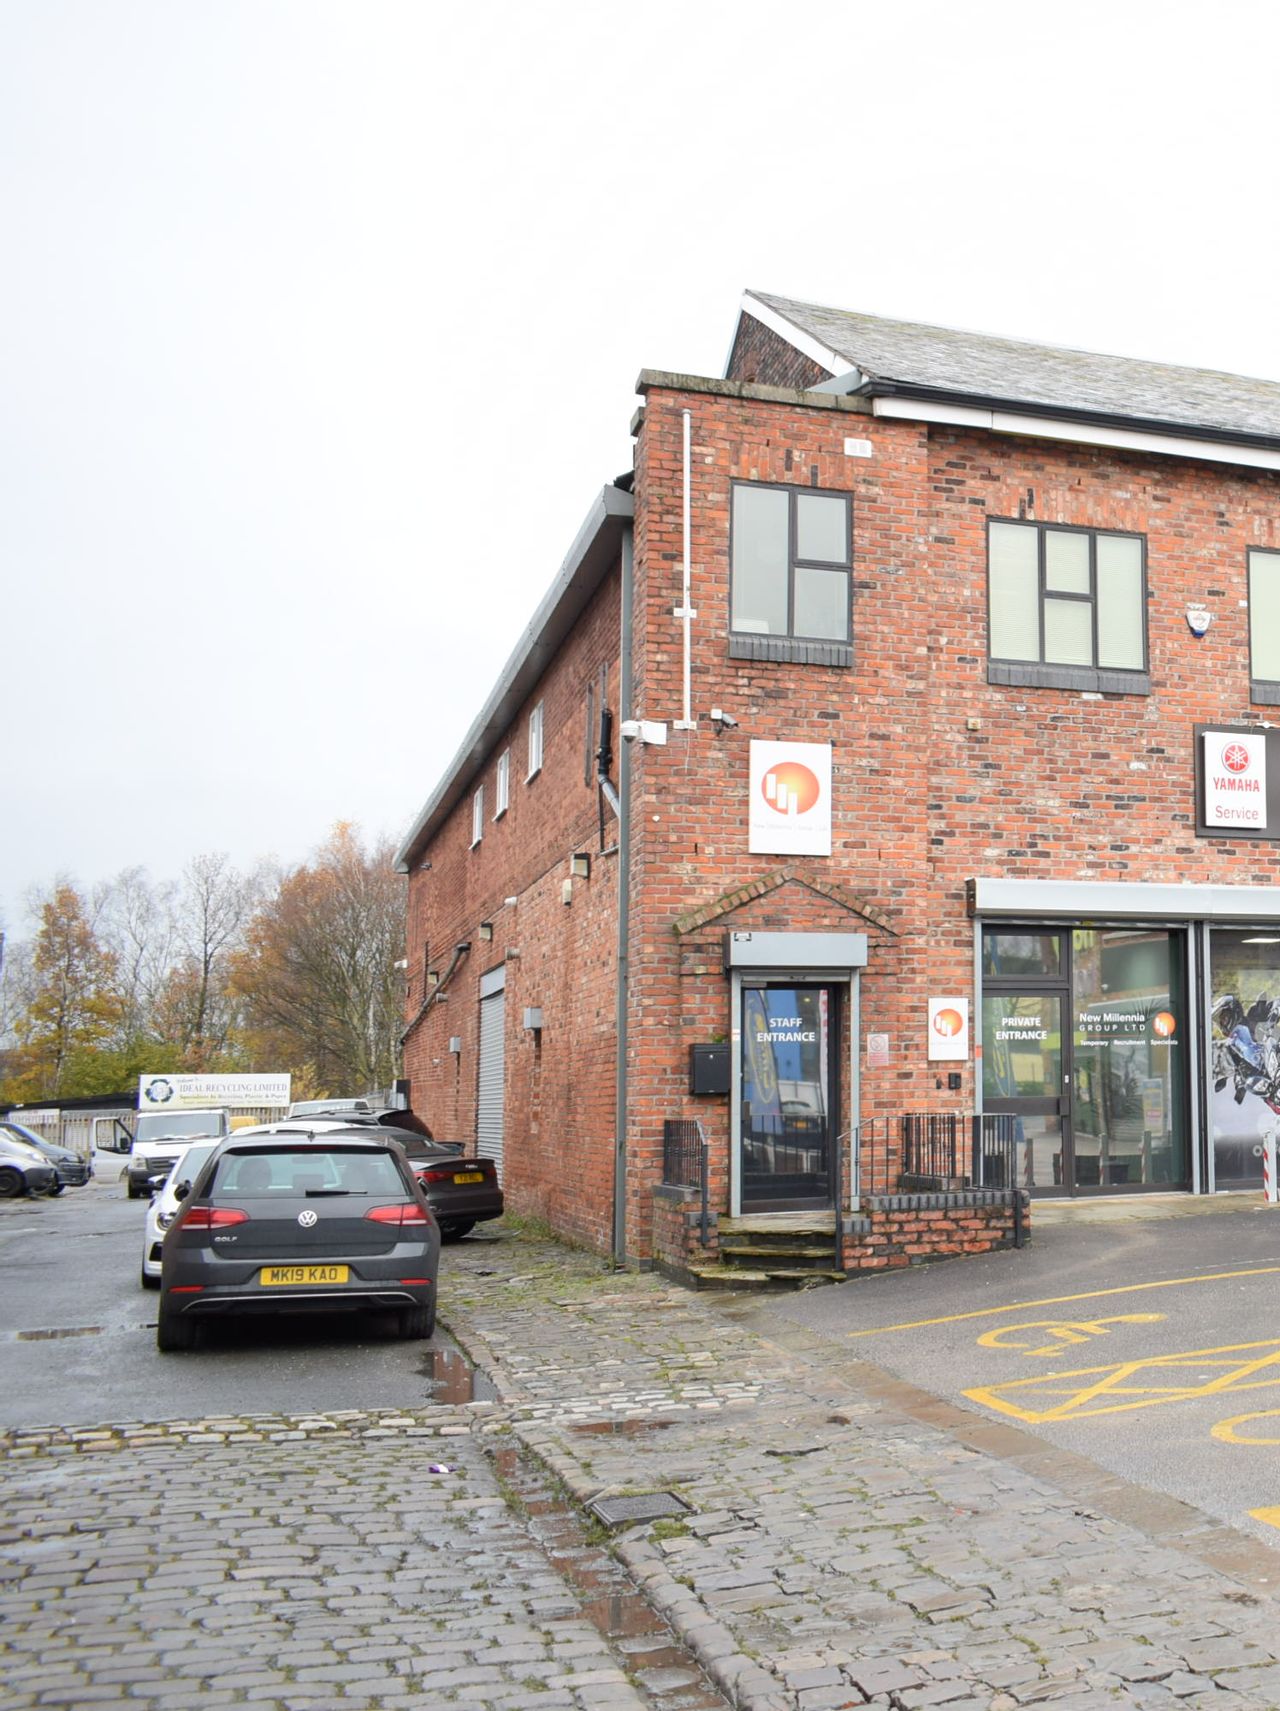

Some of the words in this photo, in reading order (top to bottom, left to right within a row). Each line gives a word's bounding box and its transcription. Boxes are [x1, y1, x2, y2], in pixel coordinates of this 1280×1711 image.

[1213, 777, 1260, 792] YAMAHA
[1215, 805, 1259, 820] Service
[769, 1017, 803, 1028] STAFF
[1001, 1017, 1041, 1027] PRIVATE
[1079, 1013, 1101, 1023] New
[1103, 1012, 1145, 1023] Millennia
[1079, 1024, 1118, 1032] GROUP
[1124, 1024, 1146, 1032] LTD
[756, 1031, 816, 1042] ENTRANCE
[995, 1030, 1048, 1041] ENTRANCE
[179, 1084, 204, 1093] IDEAL
[206, 1083, 252, 1092] RECYCLING
[254, 1083, 287, 1092] LIMITED
[270, 1268, 304, 1282] MK19
[309, 1268, 338, 1281] KAO
